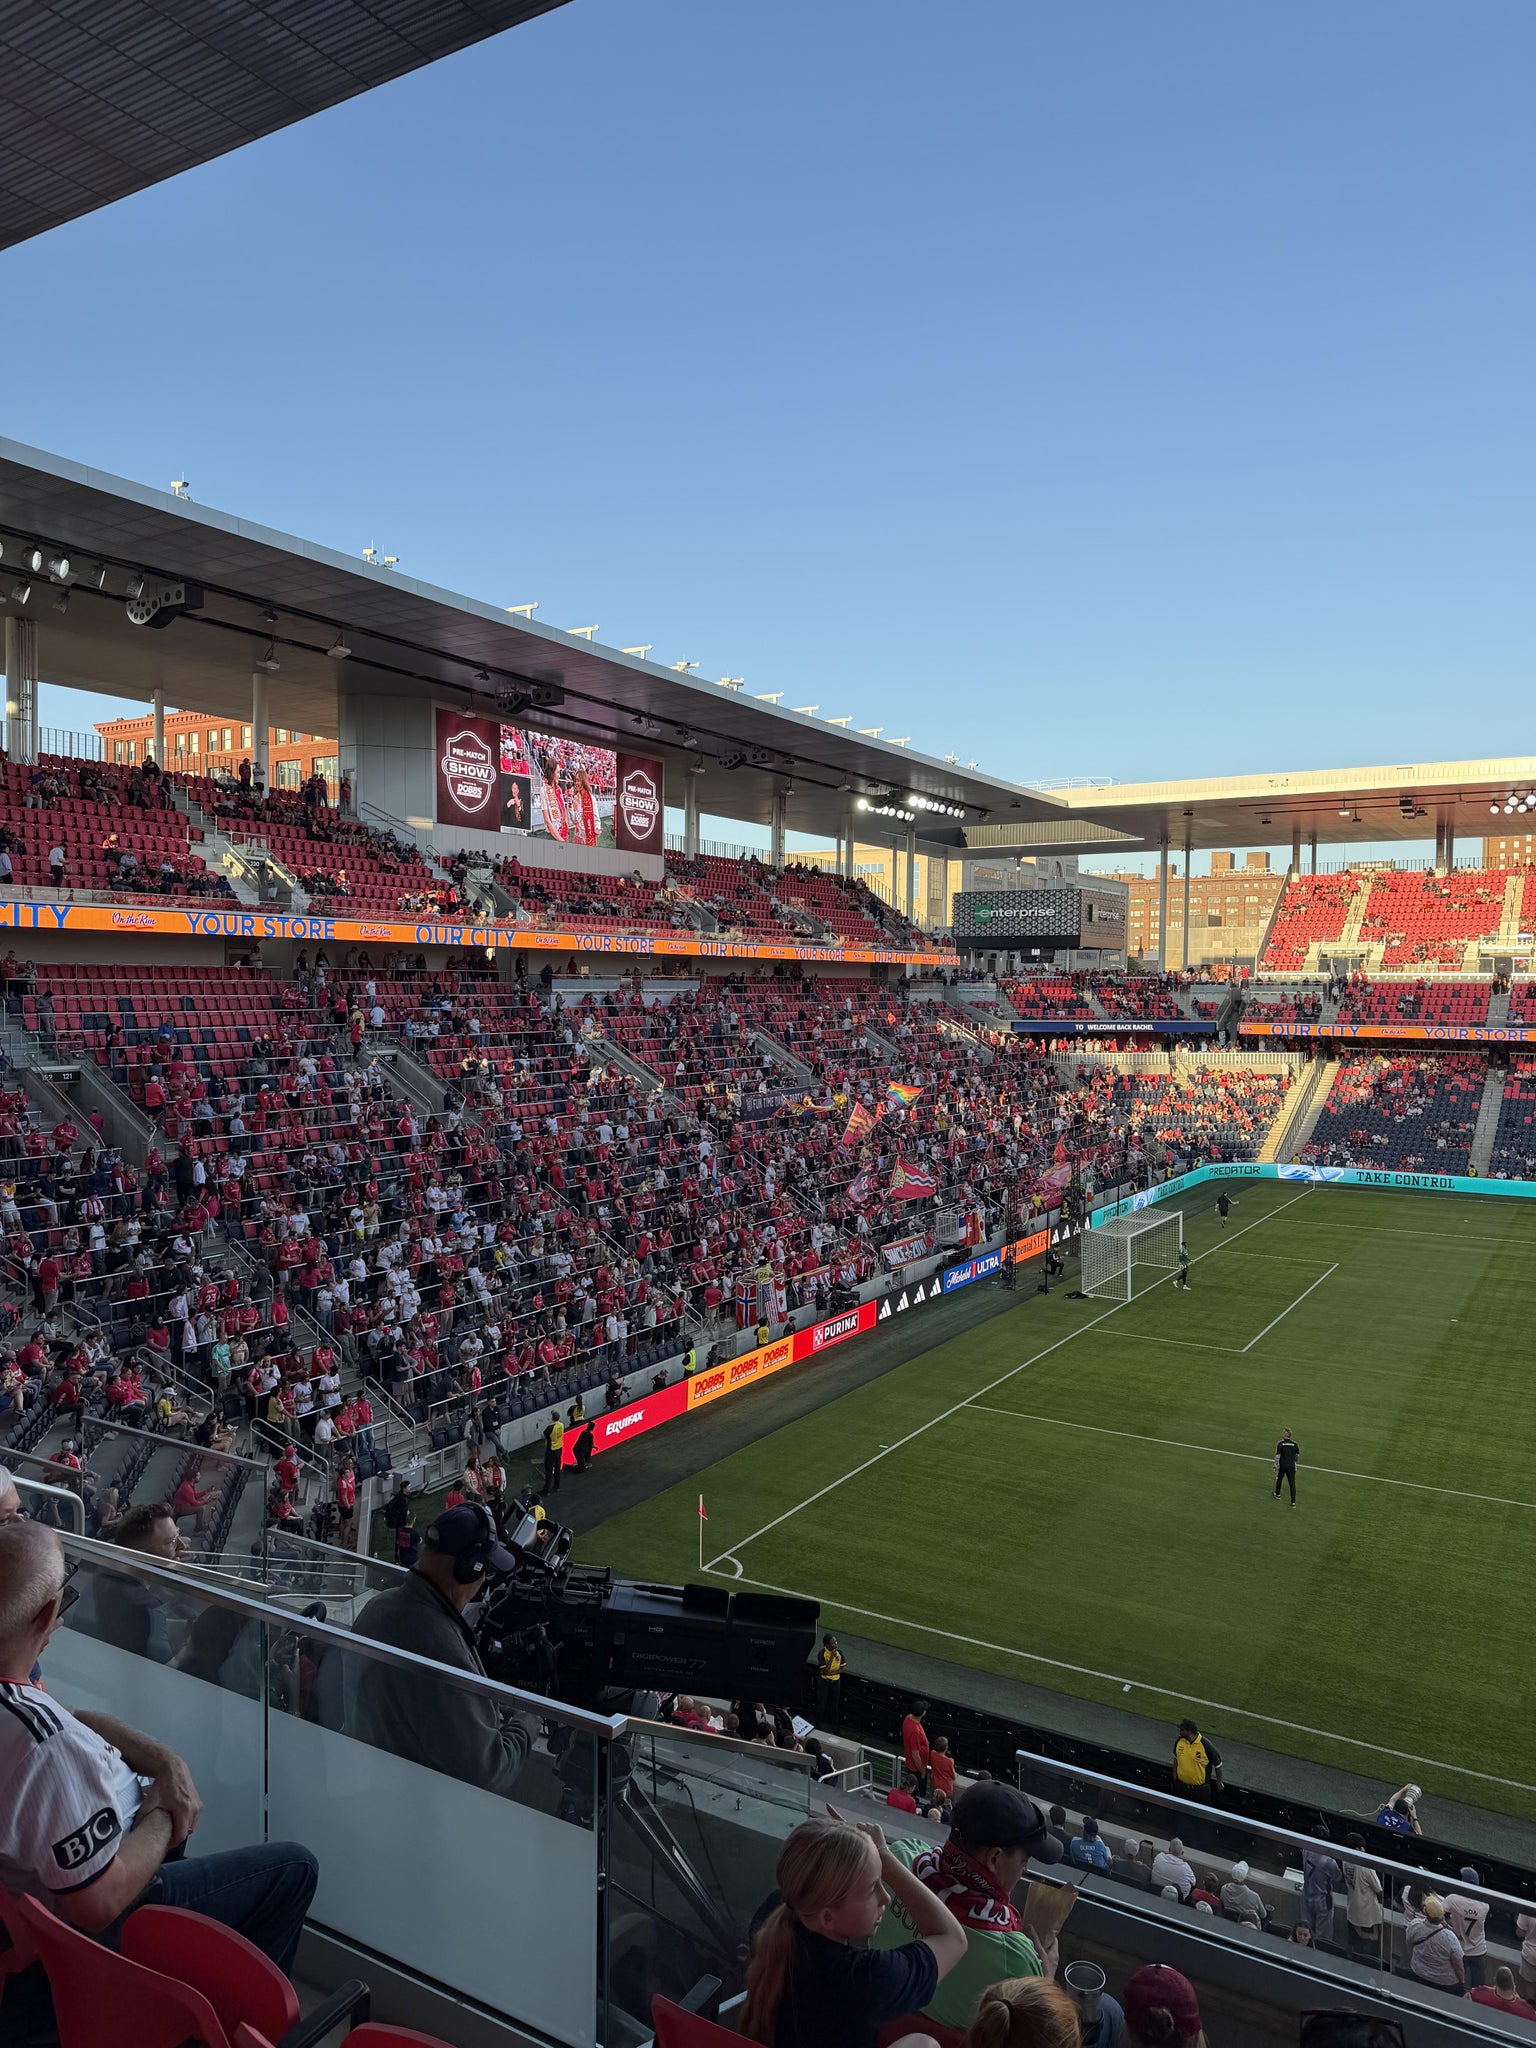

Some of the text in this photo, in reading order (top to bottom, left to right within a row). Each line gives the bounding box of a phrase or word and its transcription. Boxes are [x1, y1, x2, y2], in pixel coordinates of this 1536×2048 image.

[452, 747, 486, 761] PRE-MATCH
[448, 762, 489, 779] SHOW
[457, 783, 482, 796] DOBBS
[627, 784, 652, 796] PRE-MATCH
[625, 797, 654, 811] SHOW
[974, 906, 1056, 920] enterprise
[186, 912, 256, 936] YOUR
[264, 917, 336, 940] STORE
[415, 925, 464, 945] OUR
[470, 928, 516, 948] CITY
[574, 934, 612, 951] YOUR
[615, 938, 655, 954] STORE
[699, 942, 728, 957] OUR
[731, 944, 759, 958] CITY
[794, 947, 817, 961] YOUR
[819, 949, 845, 962] STORE
[1271, 1023, 1311, 1037] OUR
[1318, 1025, 1360, 1038] CITY
[1424, 1028, 1469, 1039] YOUR
[1475, 1029, 1528, 1041] STORE
[62, 1072, 73, 1080] 121
[1209, 1166, 1261, 1176] PREDATOR
[1357, 1171, 1455, 1189] TAKE CONTROL
[884, 1245, 907, 1266] SINCE
[977, 1255, 1000, 1274] ULTRA
[824, 1314, 858, 1340] PURINA
[762, 1343, 789, 1364] DOBBS
[730, 1356, 758, 1379] DOBBS
[694, 1371, 725, 1395] DOBBS
[605, 1409, 646, 1436] EQUIFAX
[60, 1811, 114, 1866] BJC
[1464, 1917, 1477, 1937] 7
